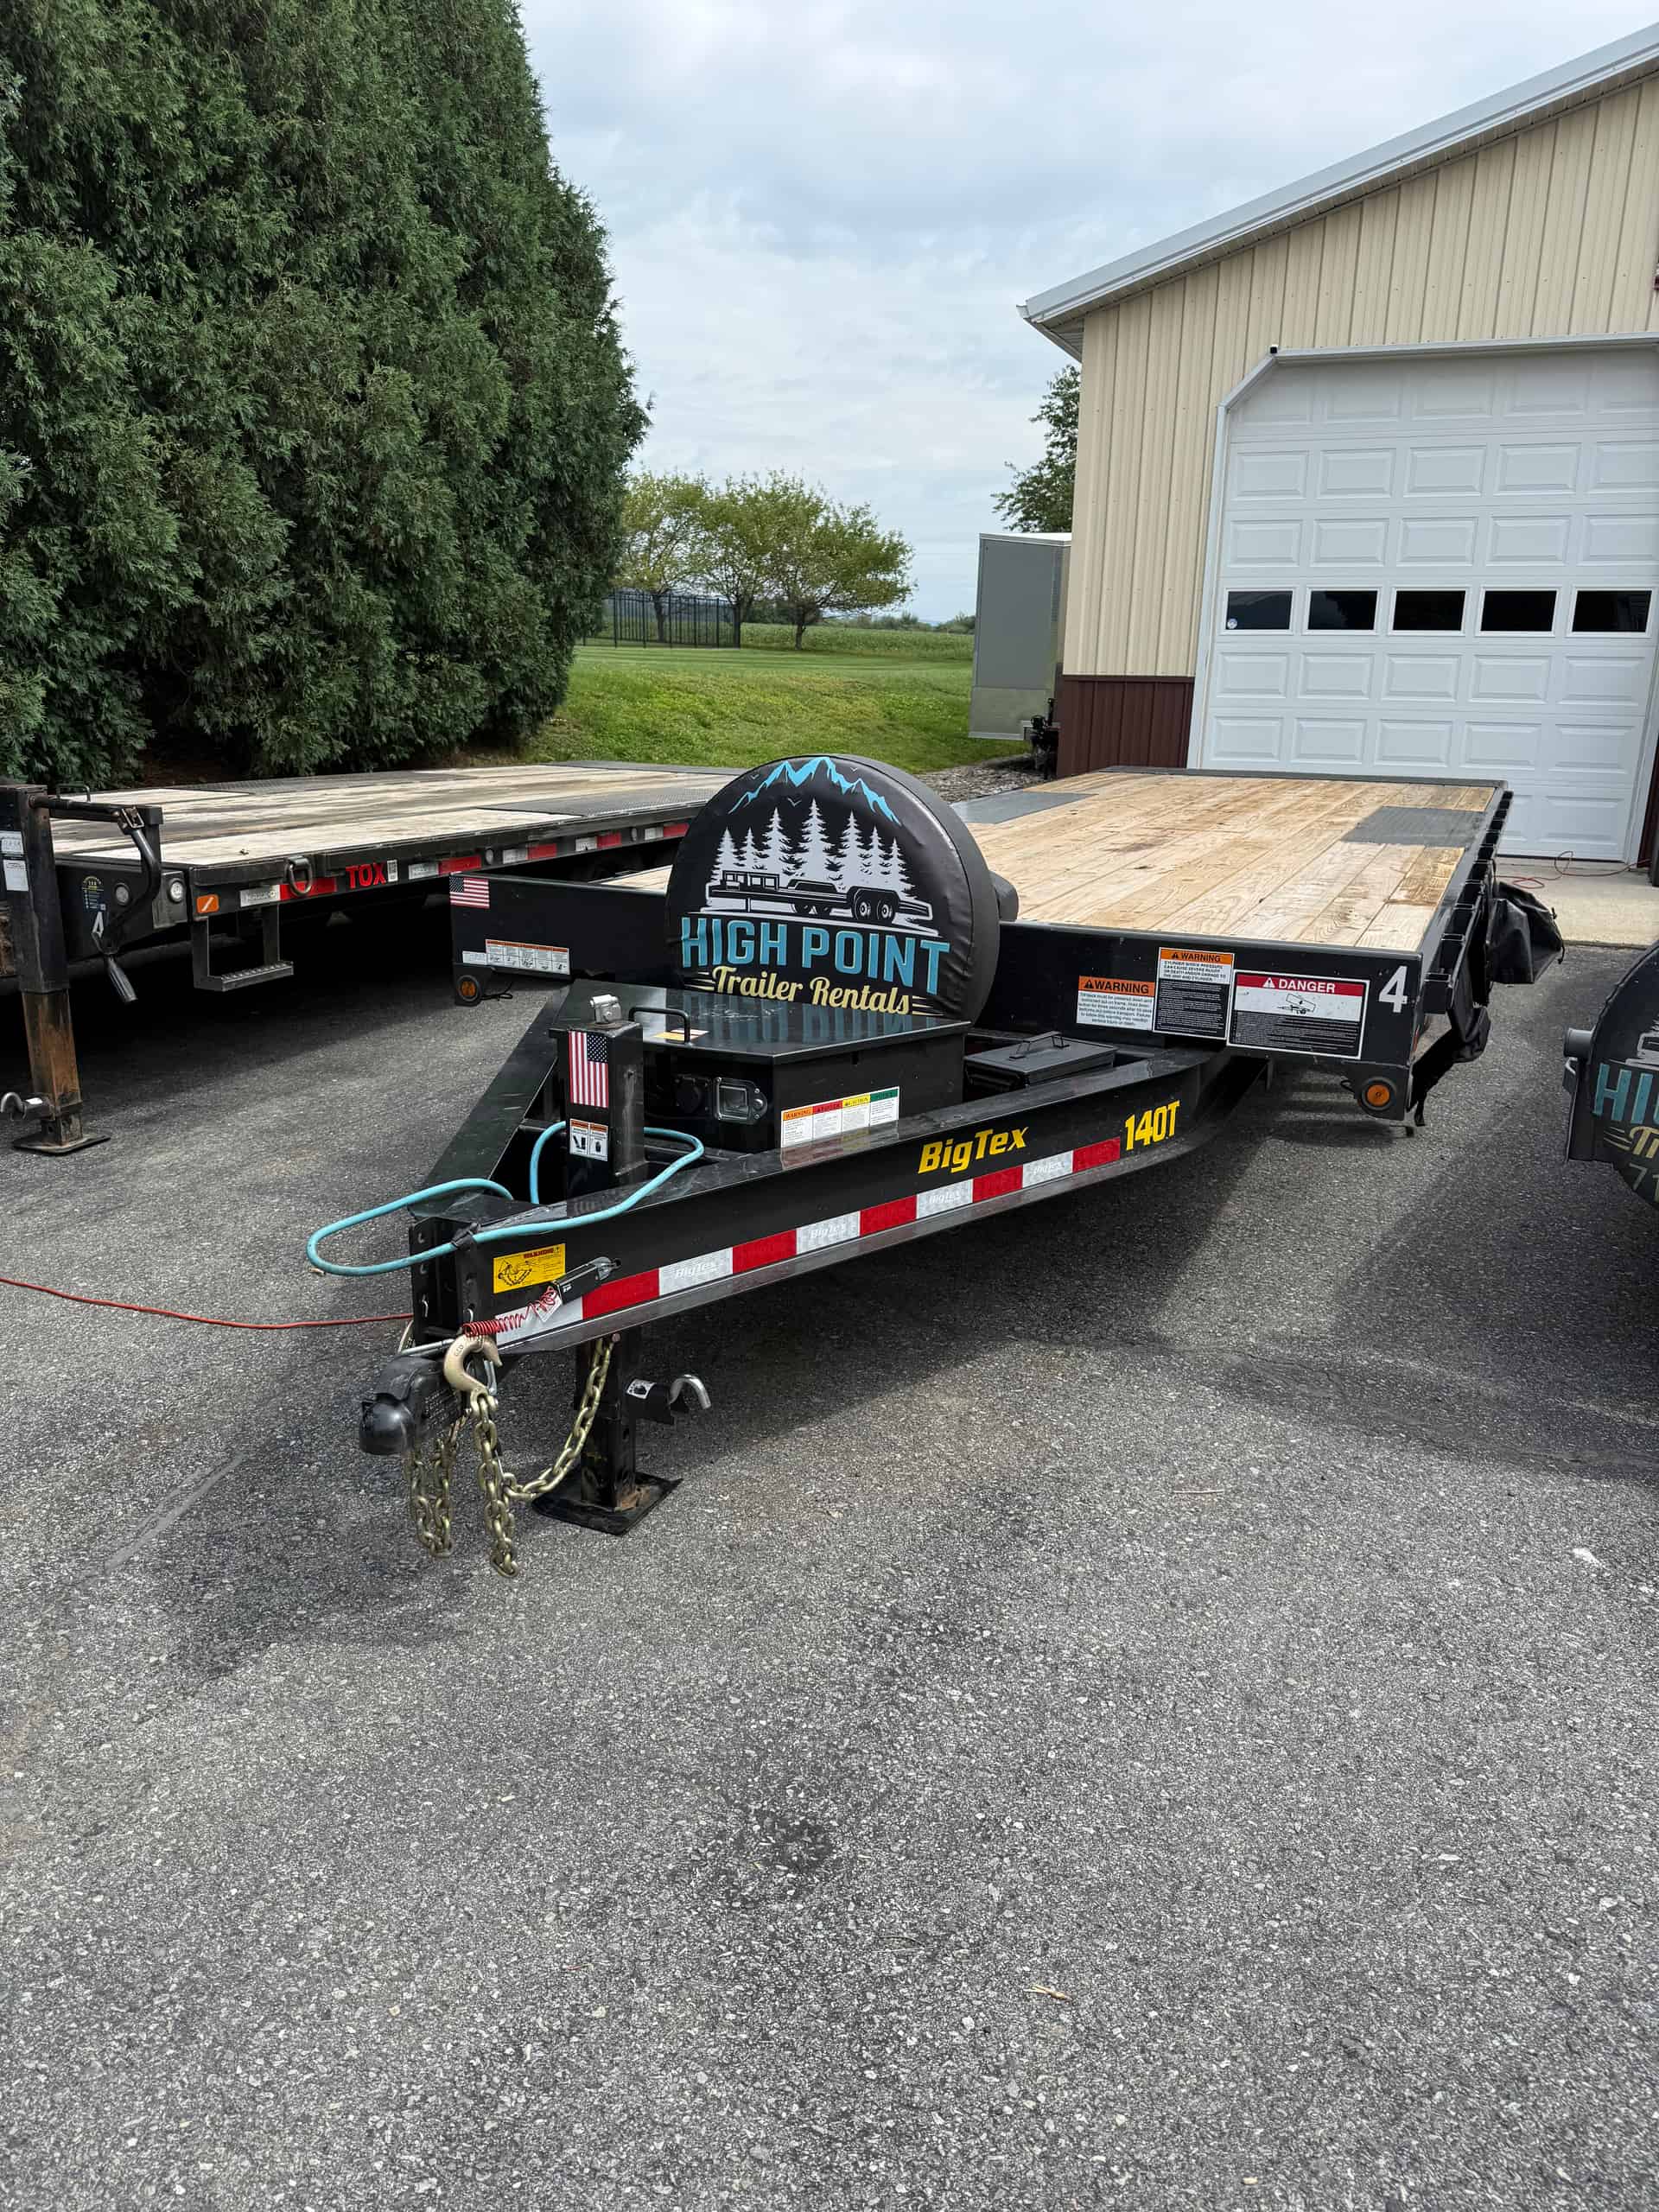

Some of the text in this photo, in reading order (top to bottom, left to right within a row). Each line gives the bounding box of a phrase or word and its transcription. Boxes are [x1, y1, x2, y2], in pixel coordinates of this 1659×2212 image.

[680, 916, 950, 995] HIGH POINT
[1180, 952, 1222, 963] WARNING
[711, 965, 912, 1015] Trailer Rentals
[1095, 979, 1149, 995] WARNING
[1278, 978, 1336, 994] DANGER
[1377, 965, 1408, 1014] 4
[1124, 1099, 1180, 1152] 140T
